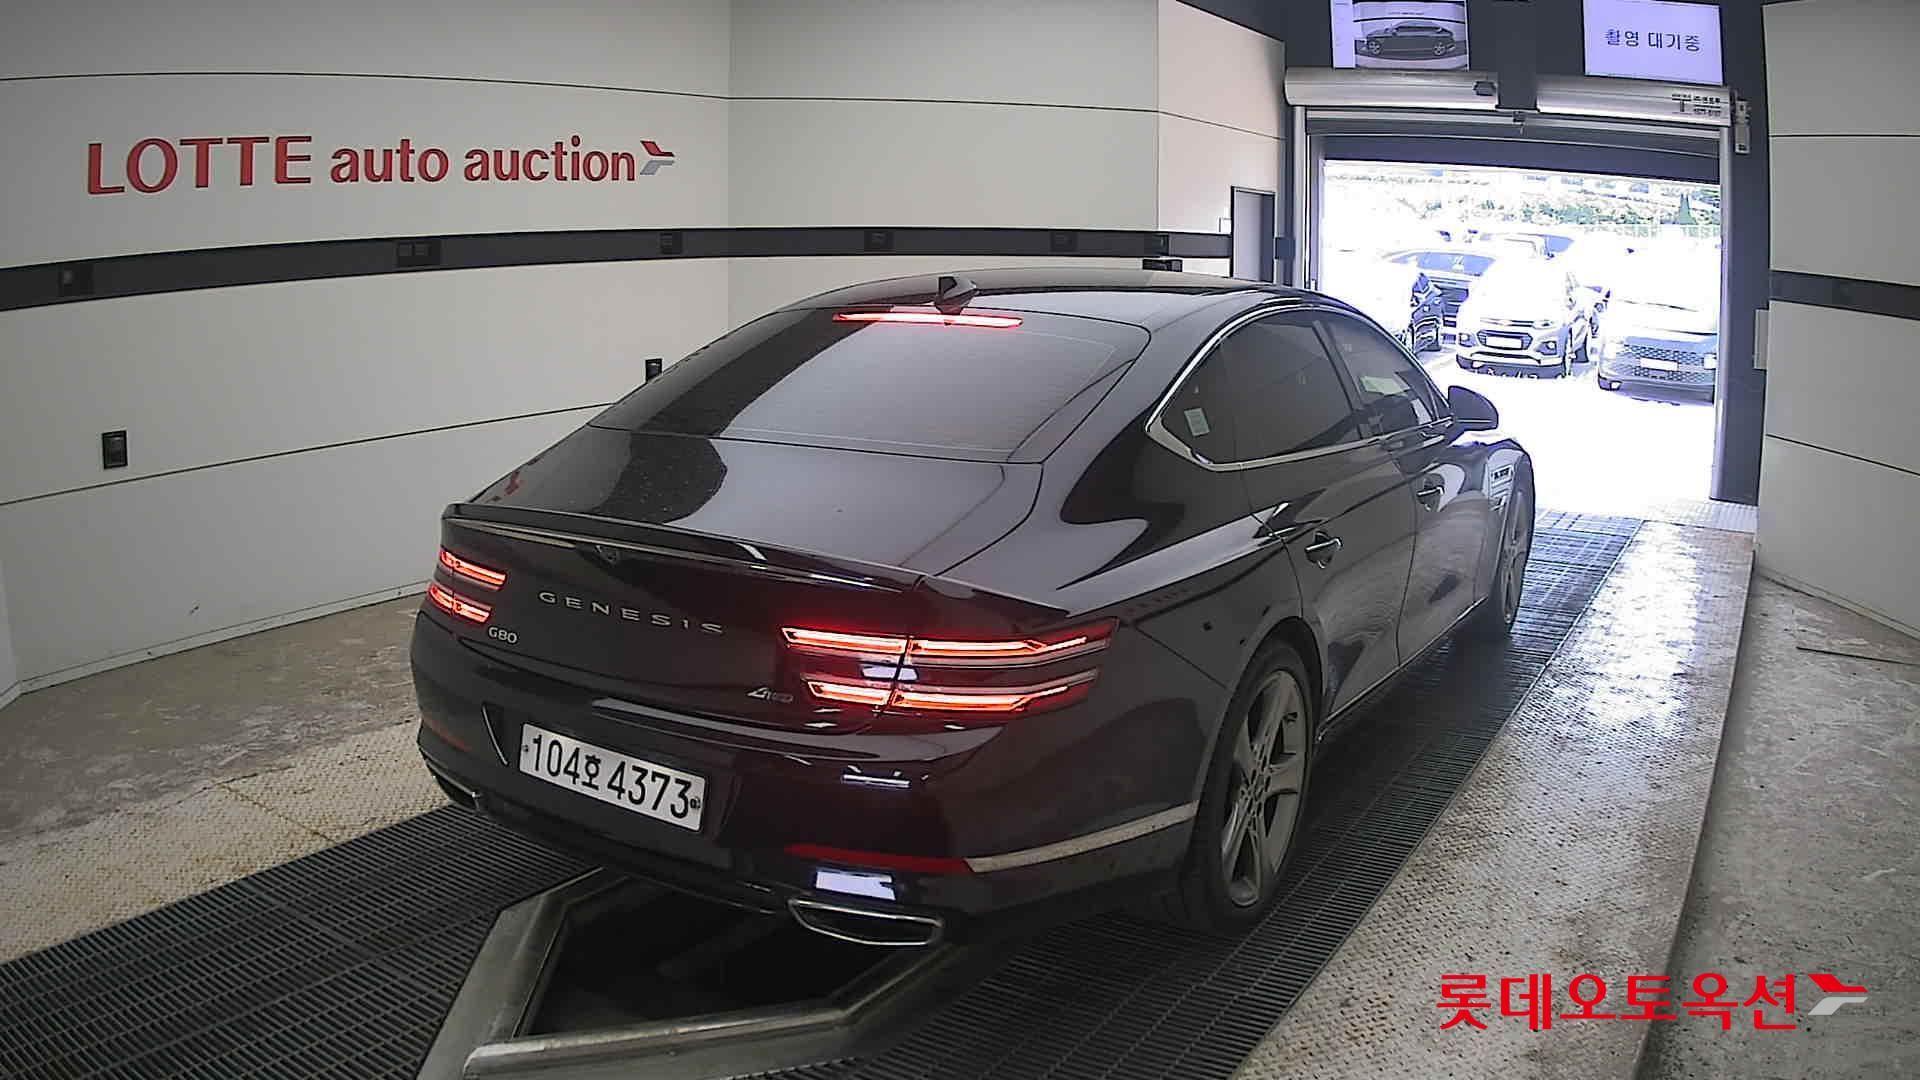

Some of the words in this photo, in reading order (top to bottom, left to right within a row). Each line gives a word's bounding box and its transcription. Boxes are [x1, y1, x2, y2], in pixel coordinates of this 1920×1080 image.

[1648, 31, 1700, 52] 대기중
[87, 135, 312, 195] LOTTE
[330, 138, 449, 183] auto
[463, 135, 635, 181] auction
[538, 591, 724, 634] GENESIS
[488, 626, 518, 644] G80
